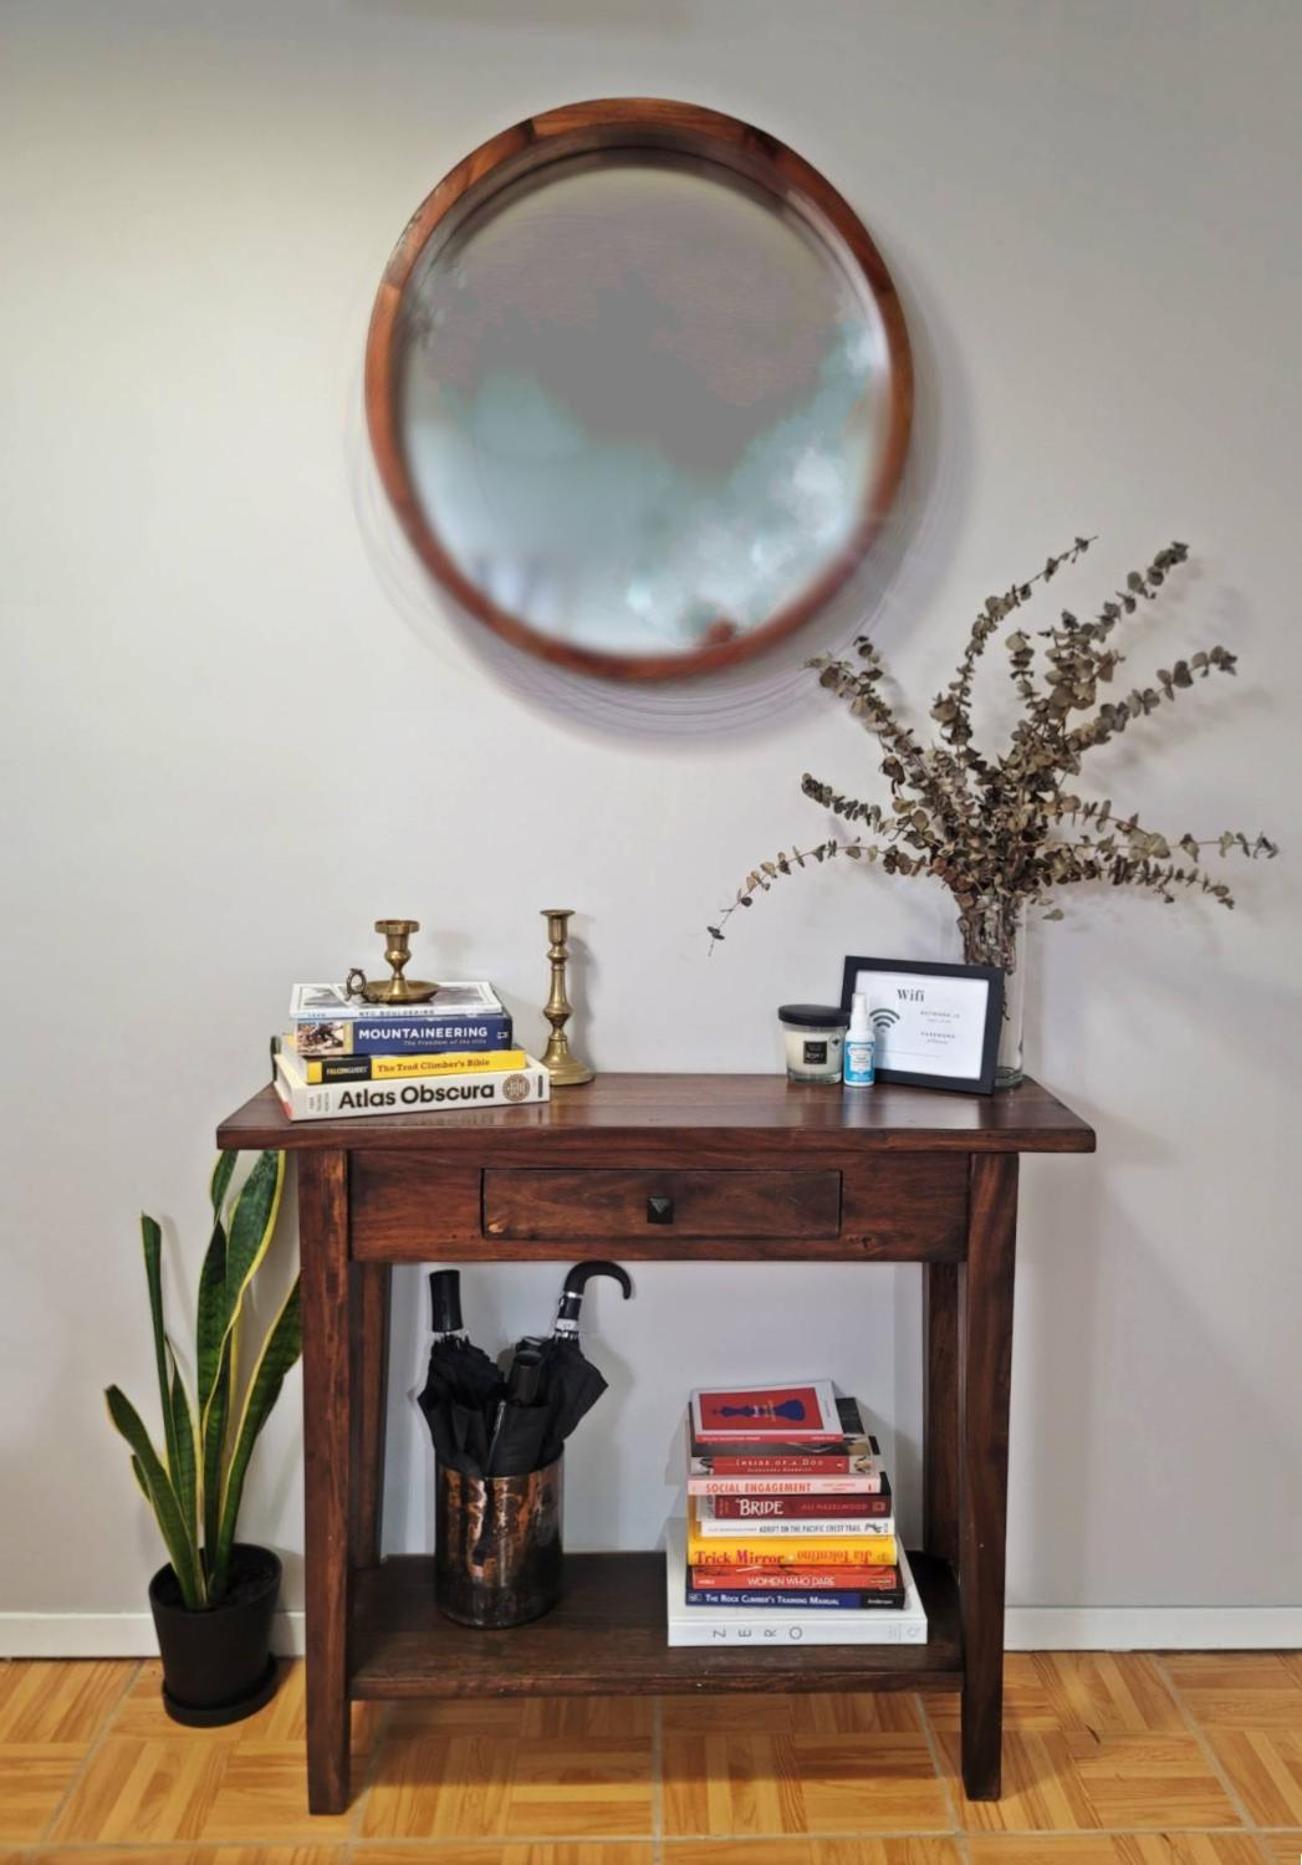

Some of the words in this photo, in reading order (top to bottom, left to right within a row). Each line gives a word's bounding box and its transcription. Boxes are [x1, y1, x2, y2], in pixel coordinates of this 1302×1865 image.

[897, 988, 925, 1002] Wifi
[358, 1027, 488, 1040] MOUNTAINEERING
[378, 1064, 395, 1072] The
[396, 1062, 418, 1071] Trad
[421, 1060, 465, 1070] Climber's
[467, 1058, 490, 1068] Bible
[338, 1088, 396, 1109] Atlas
[400, 1083, 495, 1104] Obscura
[705, 1482, 740, 1494] SOCIAL
[744, 1482, 812, 1493] ENGAGEMENT
[738, 1498, 784, 1516] BRIDE
[695, 1551, 732, 1564] Trick
[736, 1550, 783, 1564] Mirror
[746, 1576, 785, 1586] WOMEN
[786, 1576, 810, 1586] WHO
[811, 1576, 835, 1586] DARE
